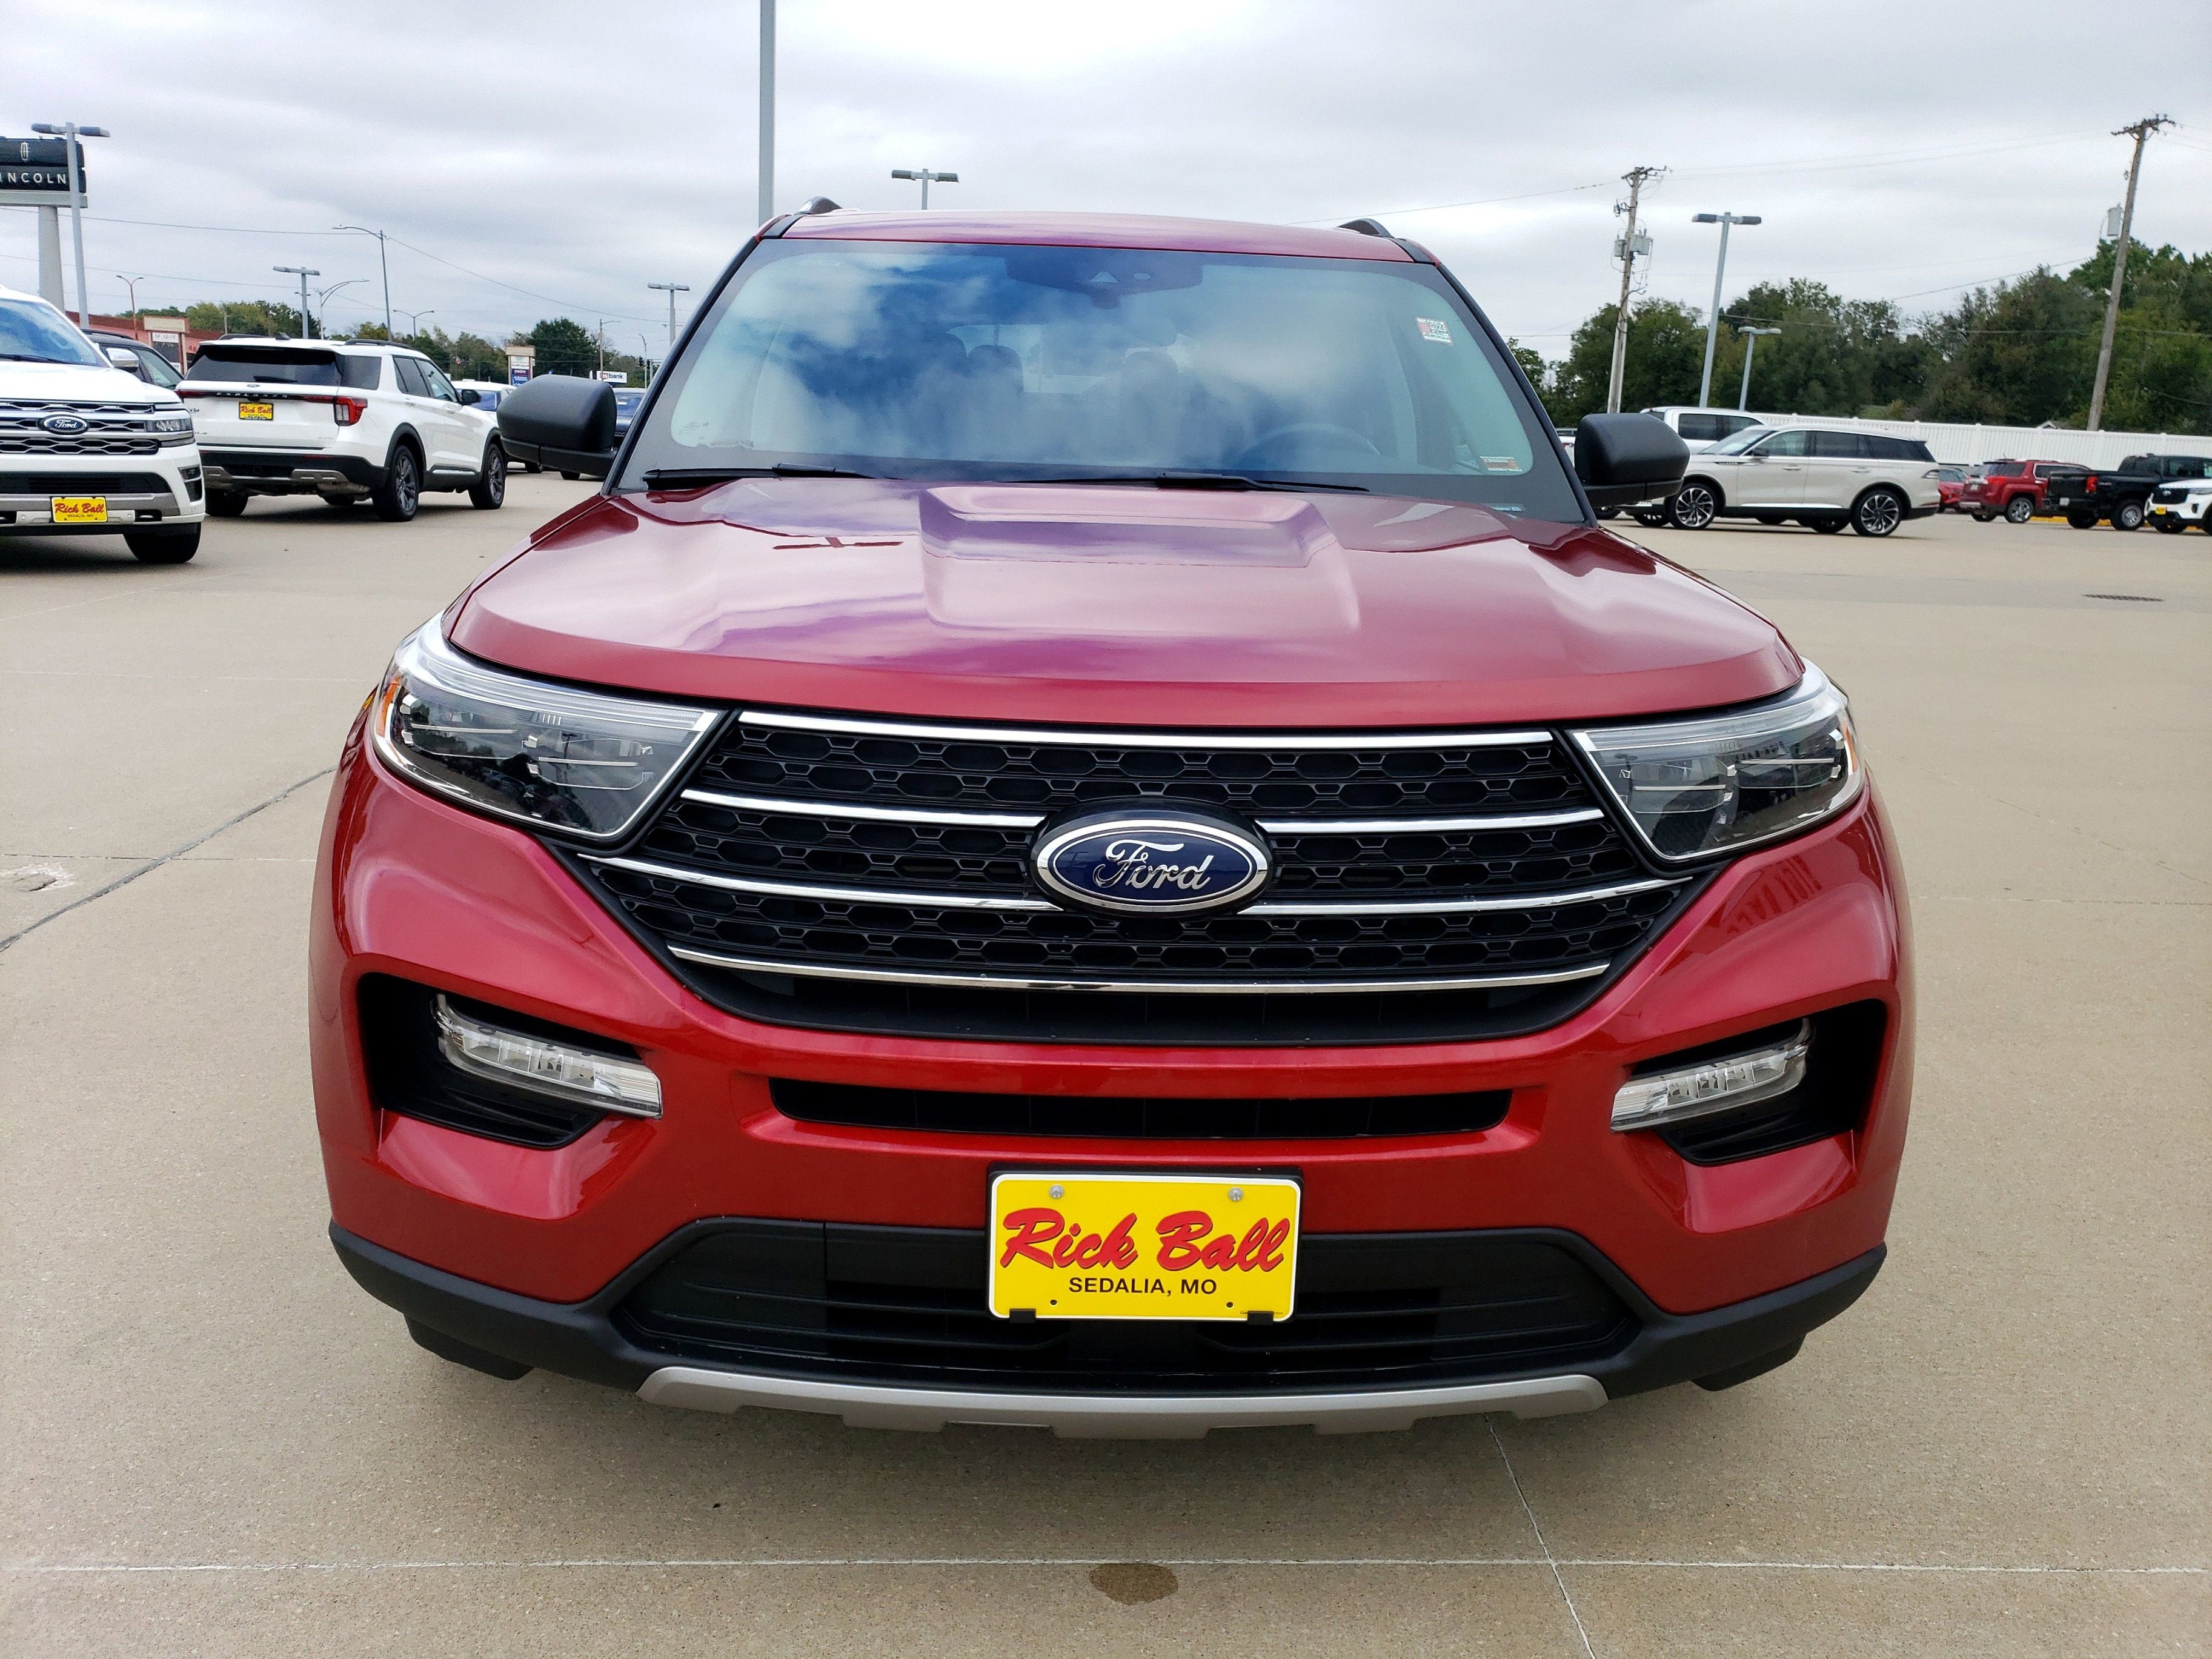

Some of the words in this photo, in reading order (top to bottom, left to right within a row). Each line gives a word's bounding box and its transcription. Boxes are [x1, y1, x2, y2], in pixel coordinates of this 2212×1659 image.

[0, 172, 67, 184] INCOLN
[55, 419, 78, 428] Ford
[55, 502, 79, 514] Rick
[81, 502, 104, 513] Ball
[1094, 839, 1214, 889] Ford
[1000, 1207, 1138, 1270] Rick
[1155, 1210, 1290, 1272] Ball
[1069, 1277, 1172, 1297] SEDALIA,
[1181, 1278, 1217, 1295] MO
